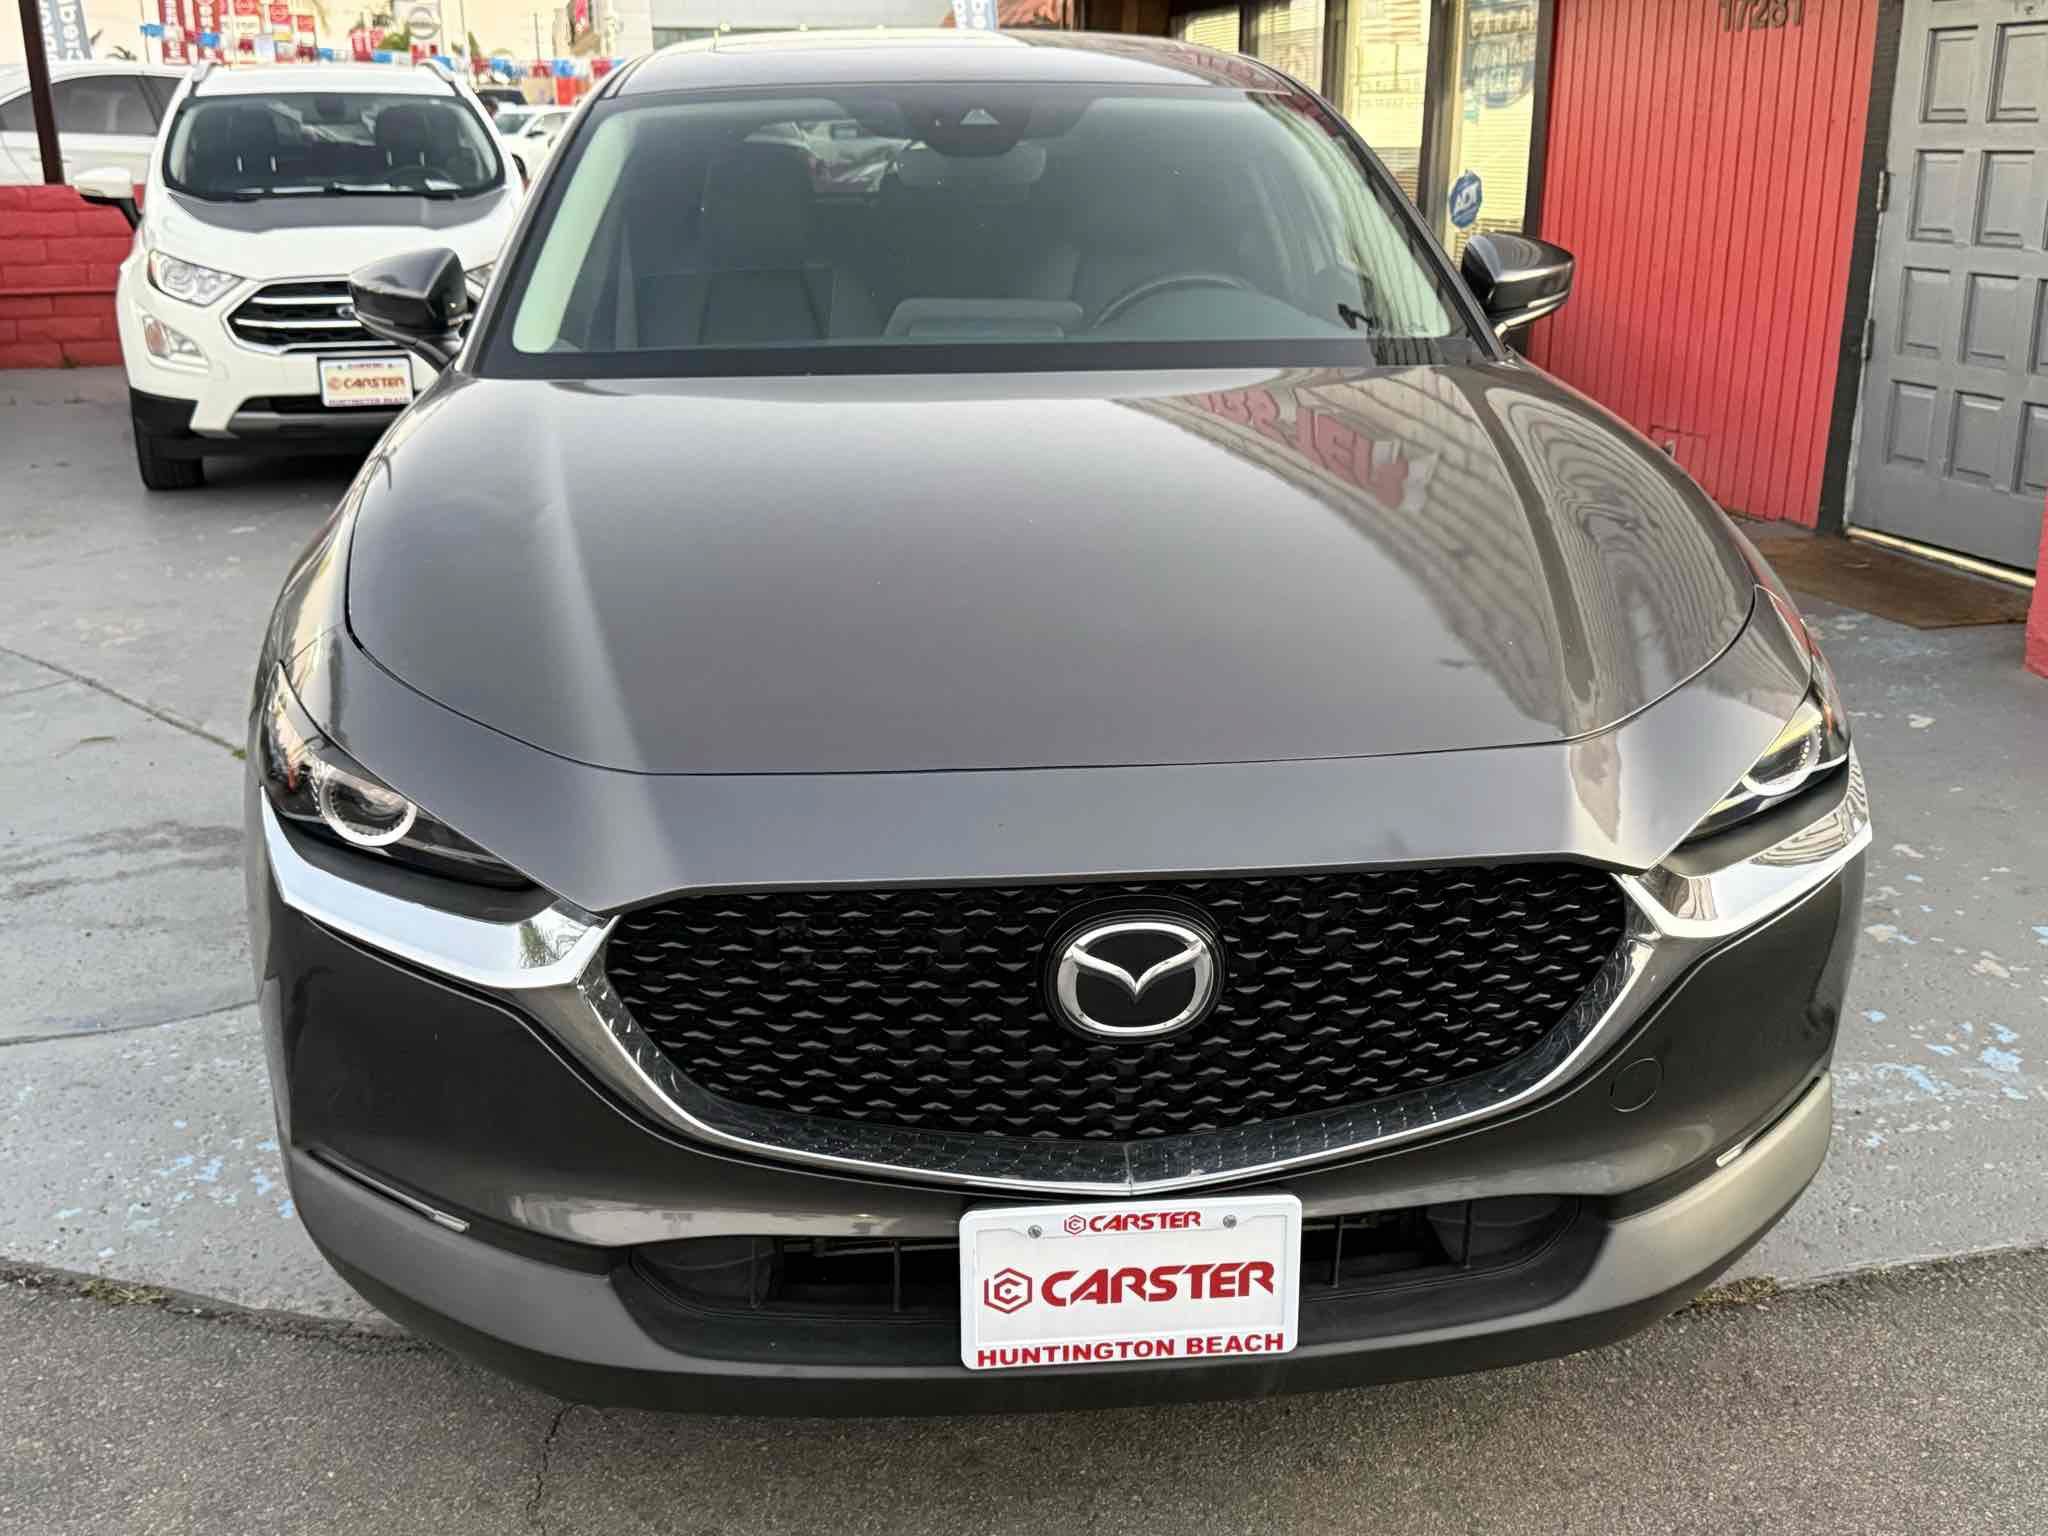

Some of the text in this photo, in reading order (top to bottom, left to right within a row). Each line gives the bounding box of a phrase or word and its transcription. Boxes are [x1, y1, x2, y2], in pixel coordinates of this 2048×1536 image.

[343, 376, 406, 389] CARSTER
[1088, 1211, 1201, 1233] CARSTER
[1040, 1260, 1275, 1308] CARSTER
[976, 1333, 1285, 1368] HUNTINGTON BEACH
